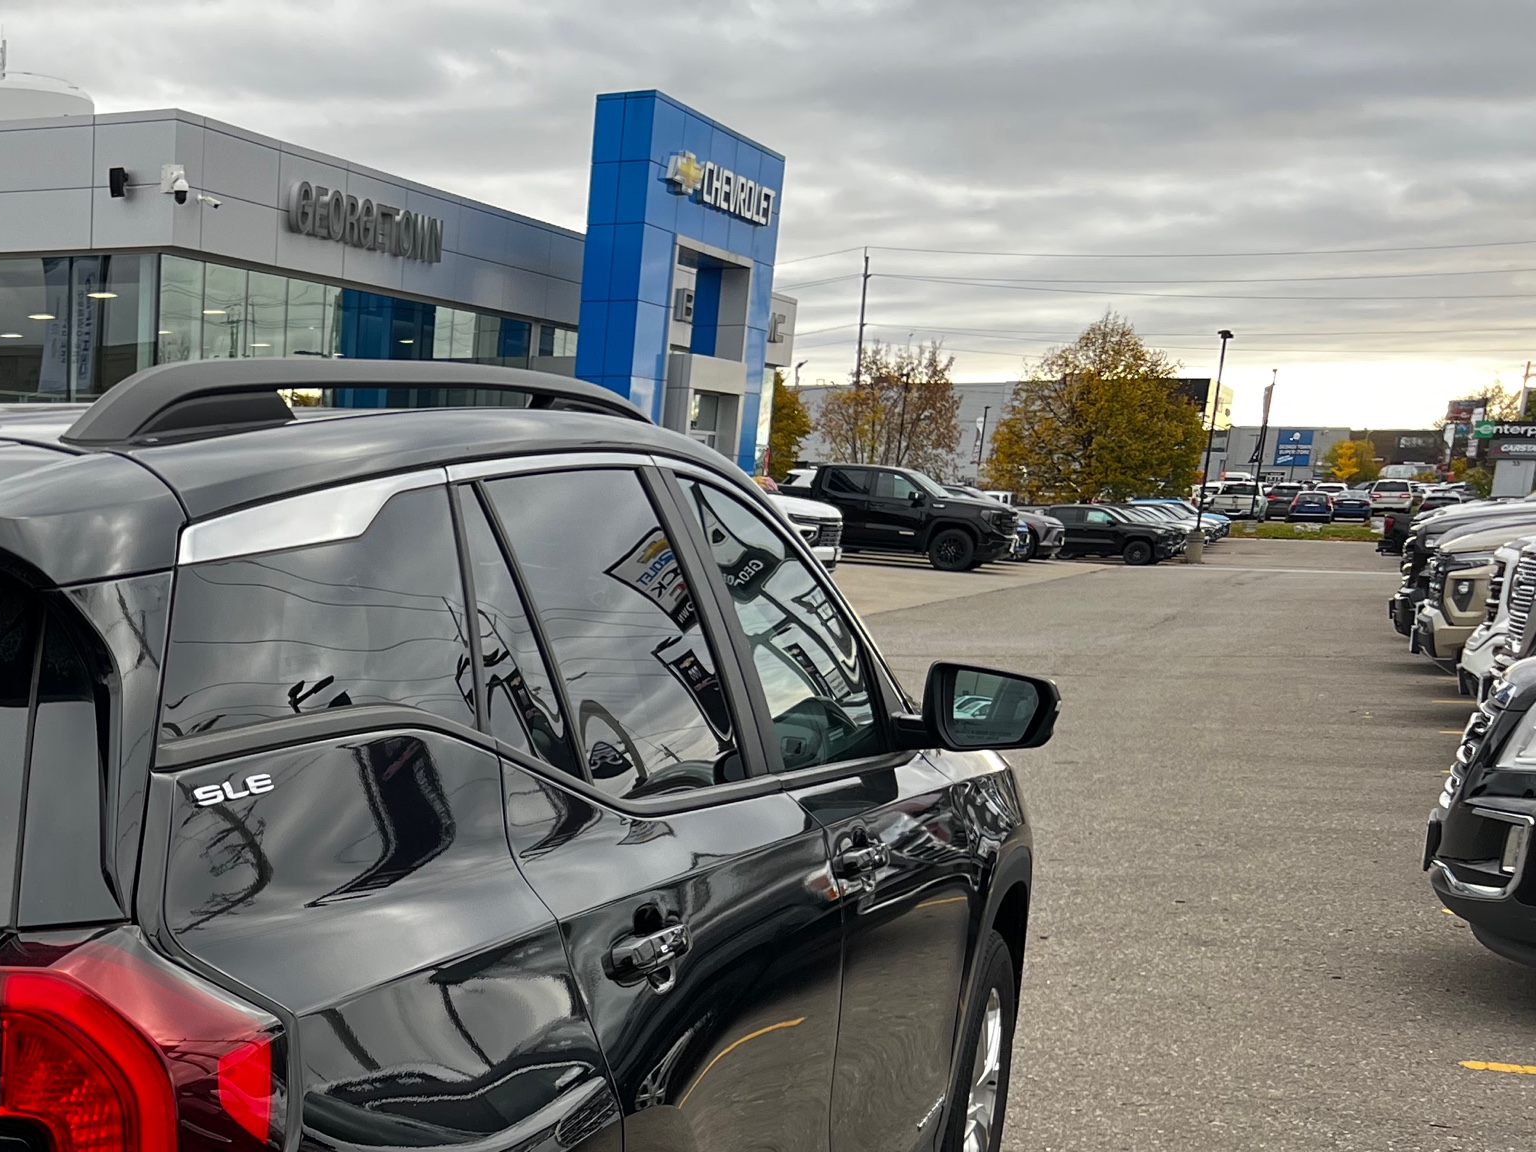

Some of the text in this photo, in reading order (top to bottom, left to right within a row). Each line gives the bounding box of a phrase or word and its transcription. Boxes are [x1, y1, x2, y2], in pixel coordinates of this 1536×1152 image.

[288, 180, 443, 263] GEORGETOWN
[702, 161, 776, 226] CHEVROLET
[193, 773, 275, 806] SLE
